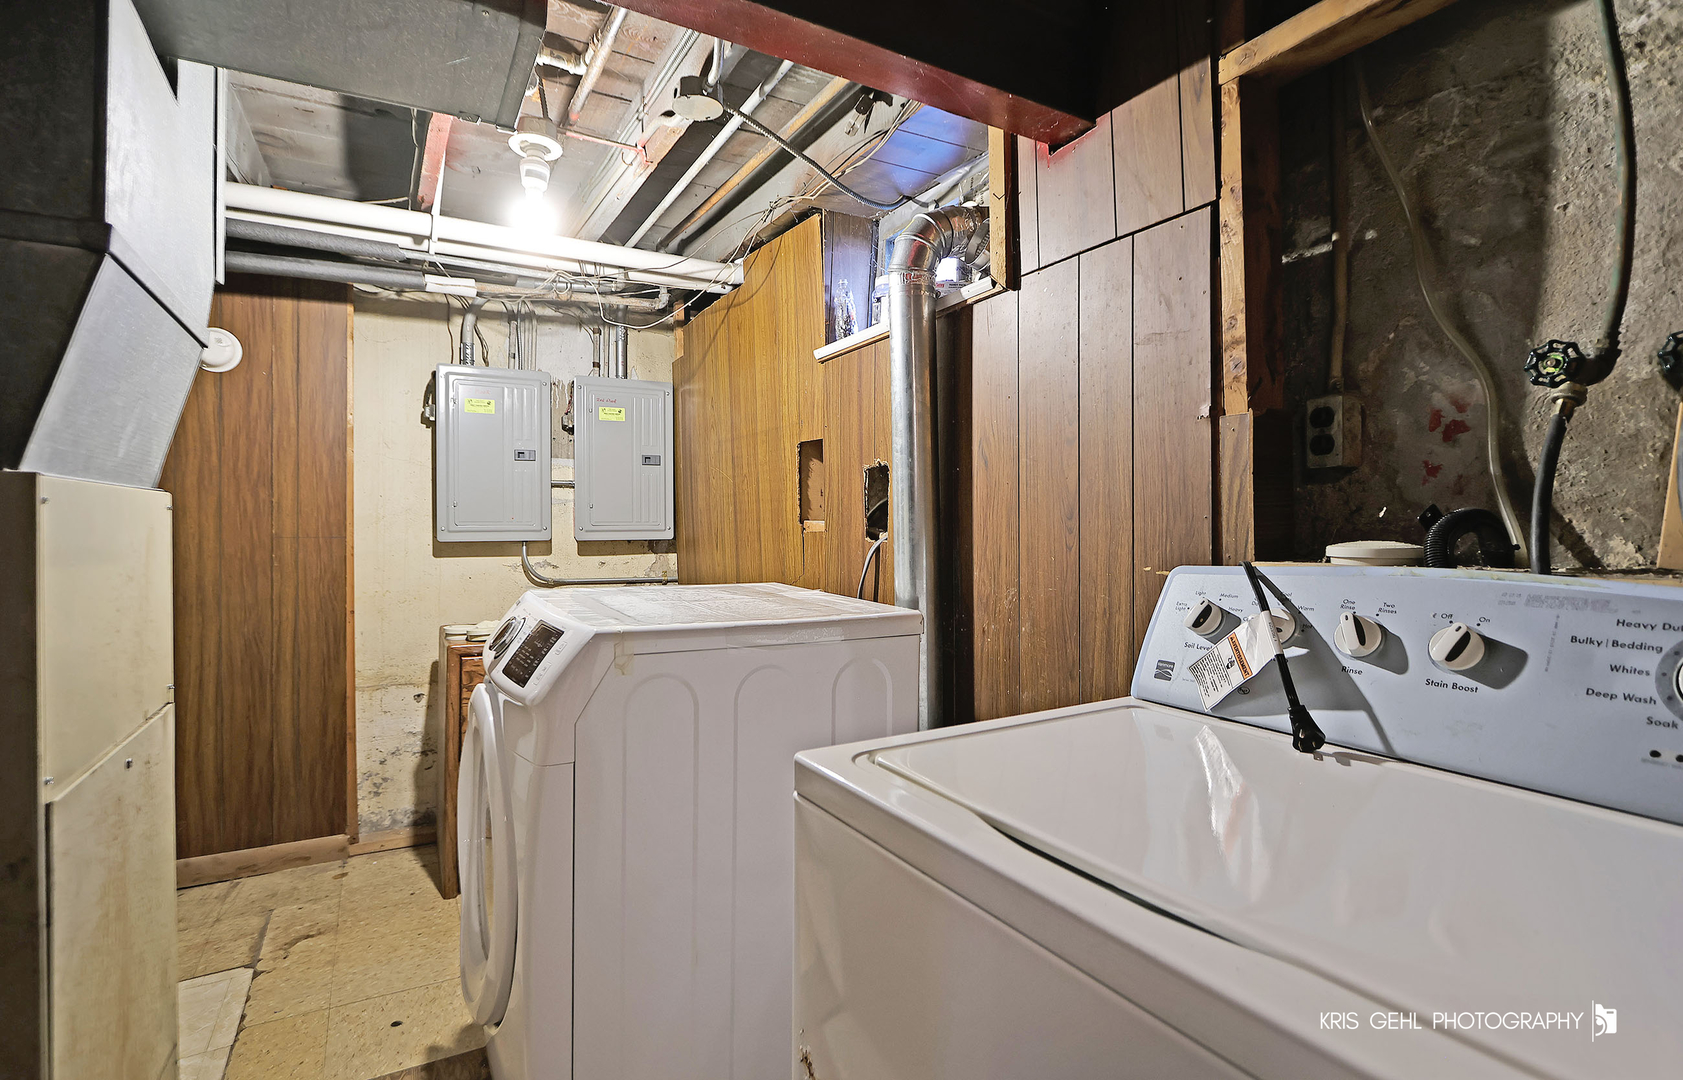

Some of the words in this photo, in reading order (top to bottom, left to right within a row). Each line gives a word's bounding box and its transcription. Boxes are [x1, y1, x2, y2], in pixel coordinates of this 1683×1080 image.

[1616, 618, 1658, 631] Heavy
[1184, 642, 1195, 650] Soil
[1570, 636, 1604, 648] Bulky
[1612, 640, 1664, 654] Bedding
[1342, 666, 1363, 676] Rinse
[1610, 664, 1651, 676] Whites
[1425, 678, 1448, 688] Stain
[1452, 682, 1478, 694] Boost
[1586, 688, 1618, 700] Deep
[1622, 692, 1658, 706] Wash
[1646, 716, 1680, 730] Soak
